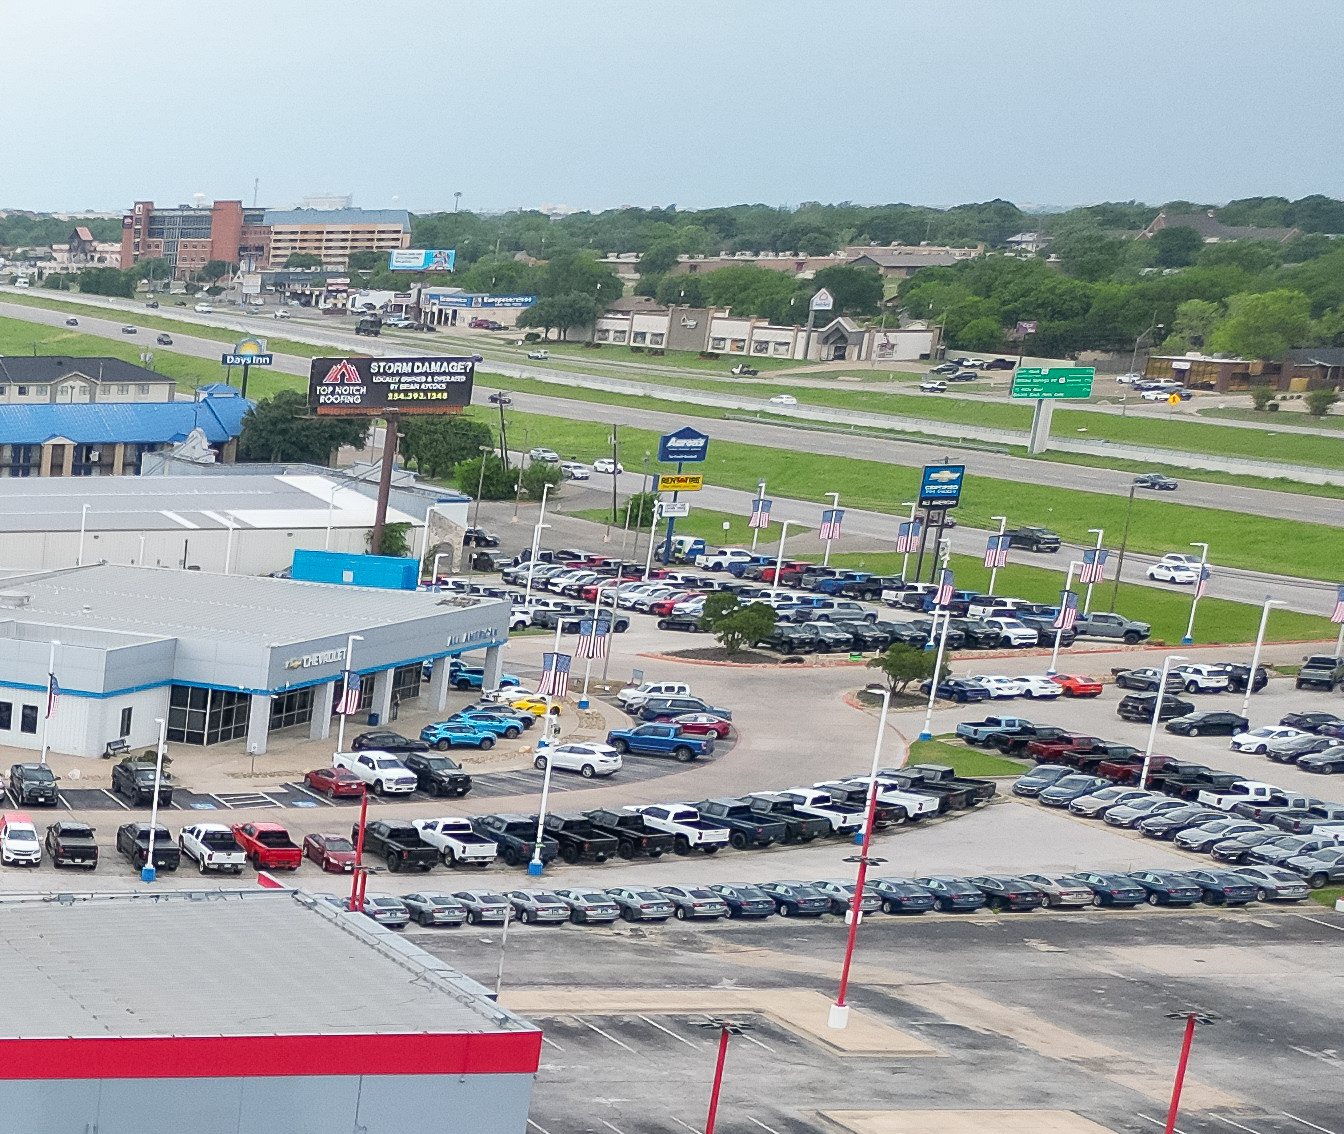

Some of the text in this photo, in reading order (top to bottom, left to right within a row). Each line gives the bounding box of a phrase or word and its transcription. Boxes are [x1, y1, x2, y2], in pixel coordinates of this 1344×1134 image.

[226, 355, 270, 365] Days Inn
[370, 361, 473, 373] STORM DAMAGE?
[316, 386, 367, 394] TOP NOTCH
[319, 394, 362, 404] ROOFING
[303, 648, 348, 668] CHEVROLET
